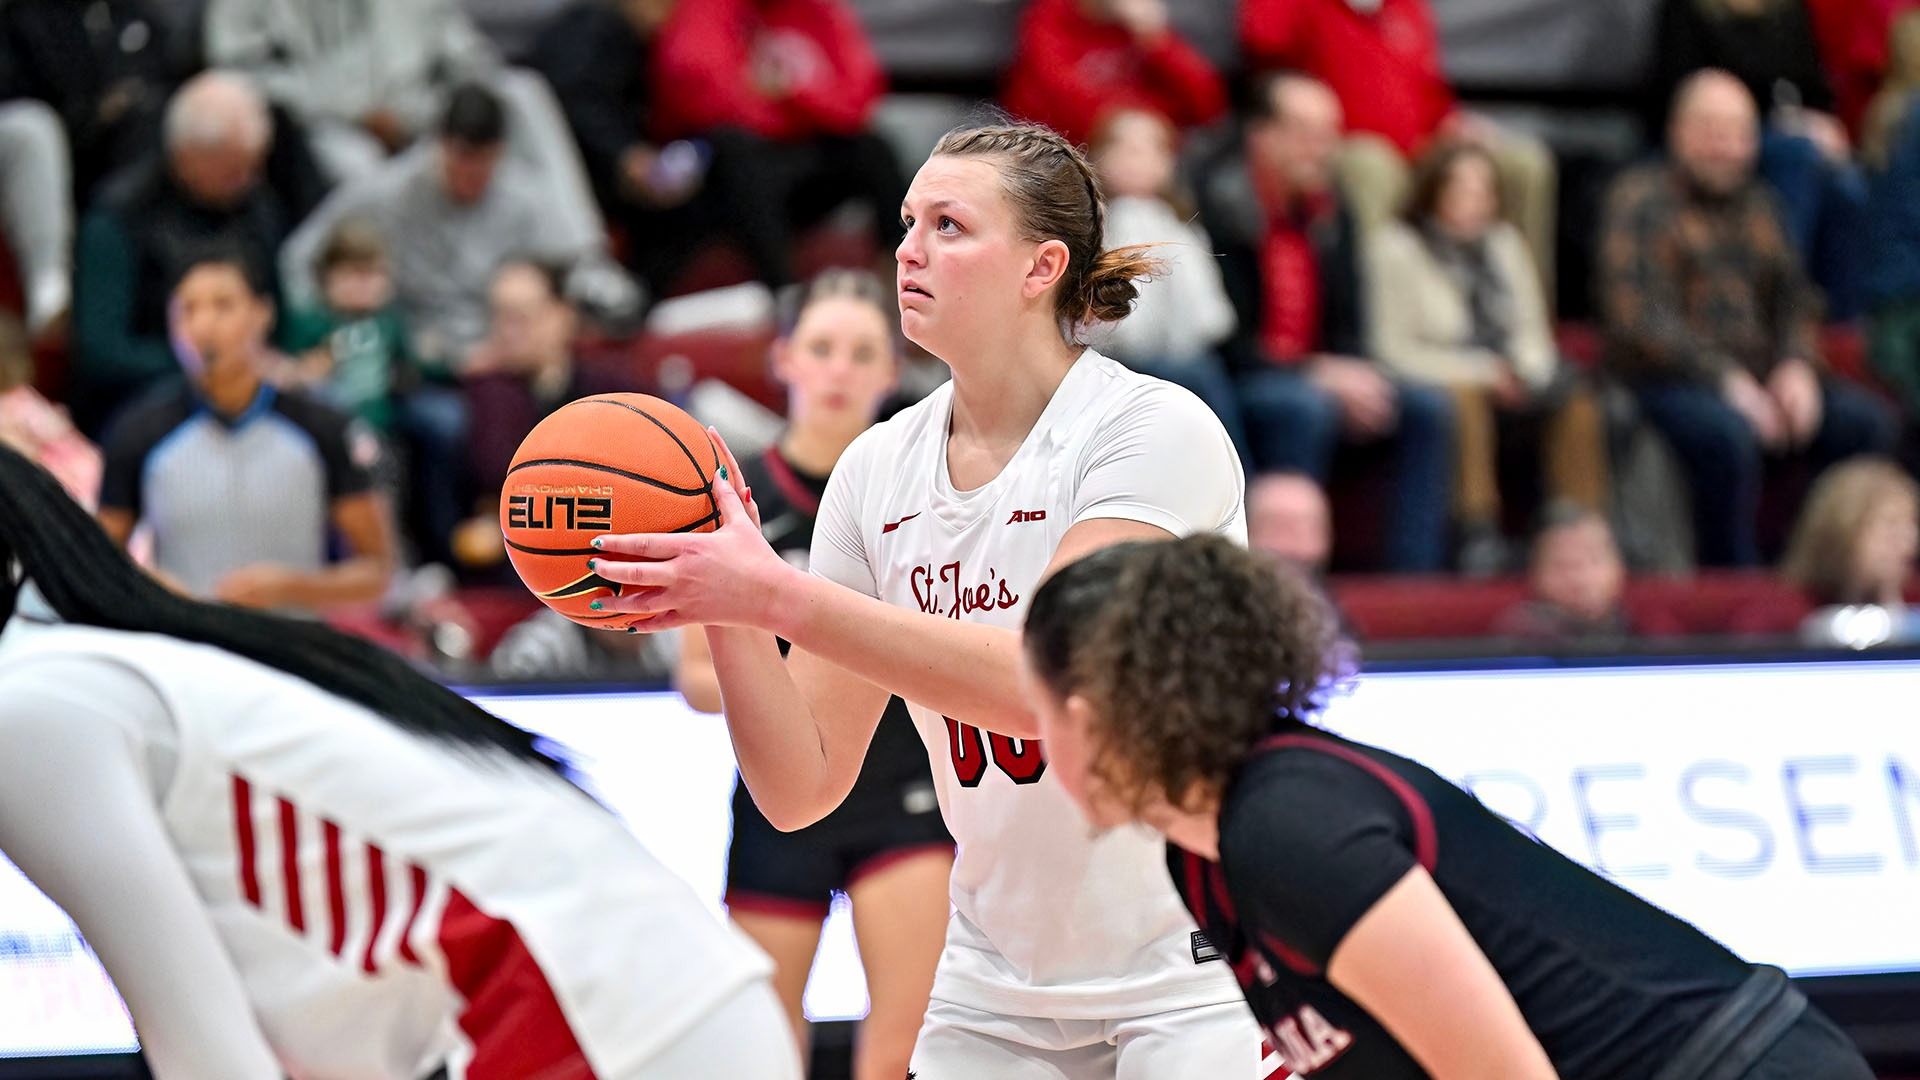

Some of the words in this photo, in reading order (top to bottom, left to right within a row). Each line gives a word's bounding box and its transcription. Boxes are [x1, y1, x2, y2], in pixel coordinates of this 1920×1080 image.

[509, 496, 612, 531] ELITE
[1005, 509, 1047, 525] A10
[910, 563, 944, 614] St.
[939, 560, 1019, 620] Joe's
